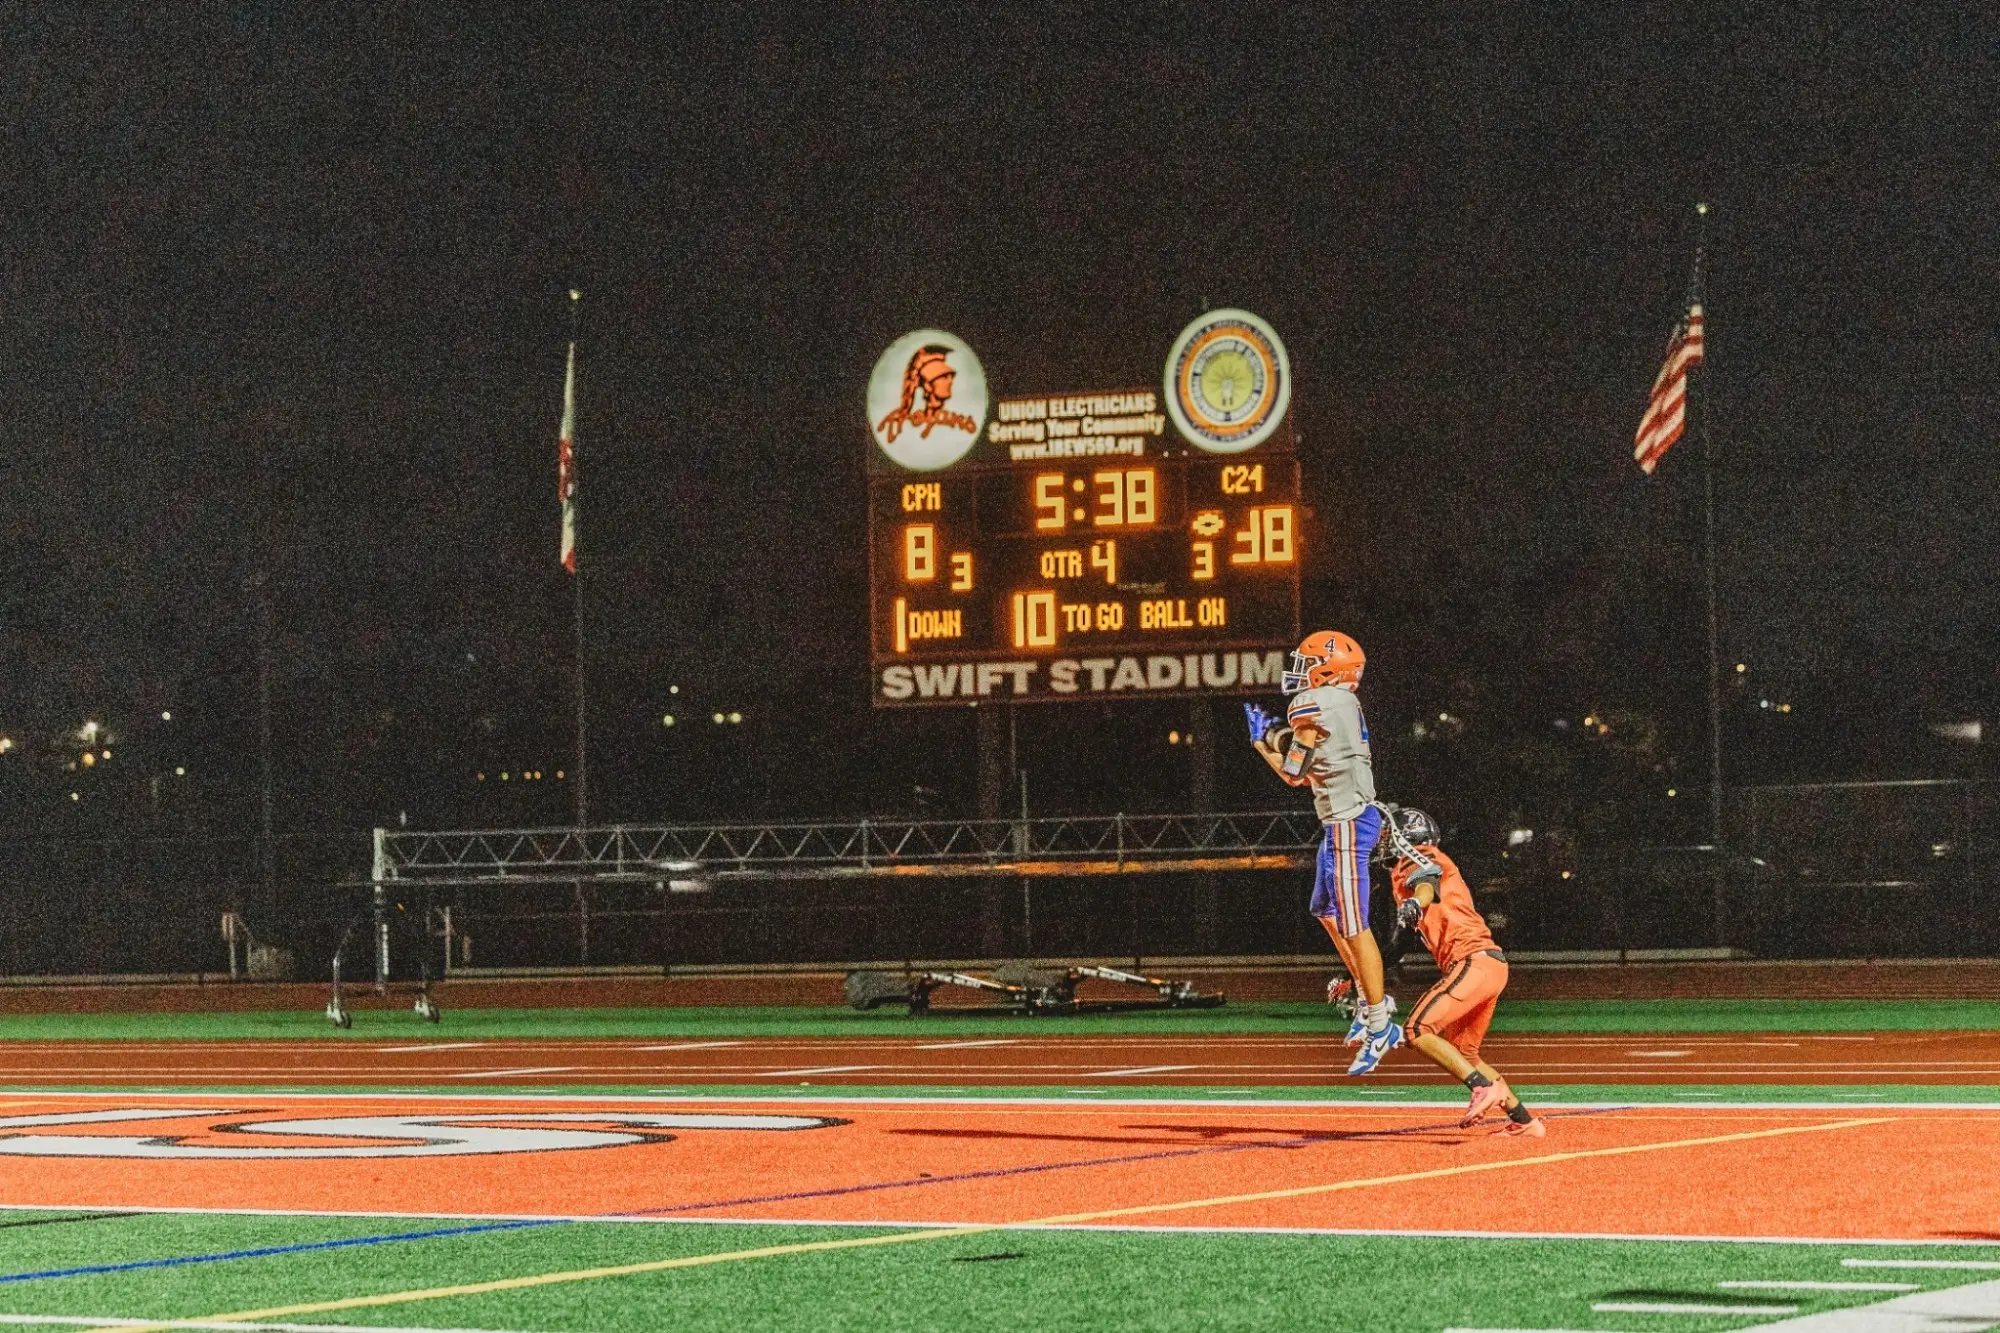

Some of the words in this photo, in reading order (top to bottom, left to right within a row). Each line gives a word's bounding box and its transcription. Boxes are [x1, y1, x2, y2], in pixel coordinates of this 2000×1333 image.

[877, 407, 977, 443] Trojans
[998, 400, 1047, 421] UNION
[1049, 392, 1157, 417] ELECTRICIANS
[988, 421, 1045, 443] Serving
[1045, 418, 1080, 438] Your
[1081, 413, 1166, 436] Community
[902, 482, 941, 511] CPH
[1221, 464, 1263, 494] C24
[1036, 470, 1155, 529] 5:38
[906, 526, 934, 580] 8
[951, 552, 972, 590] 3
[1040, 550, 1082, 579] QTR
[1091, 540, 1116, 584] 4
[1193, 541, 1214, 579] 3
[896, 599, 906, 652] 1
[908, 609, 961, 640] DOWN
[1014, 592, 1056, 648] 10
[1061, 604, 1092, 632] TO
[1097, 602, 1124, 631] GO
[1140, 600, 1193, 629] BALL
[1324, 637, 1336, 653] 4
[881, 661, 1038, 699] SWIFT
[1050, 650, 1284, 693] STADIUM
